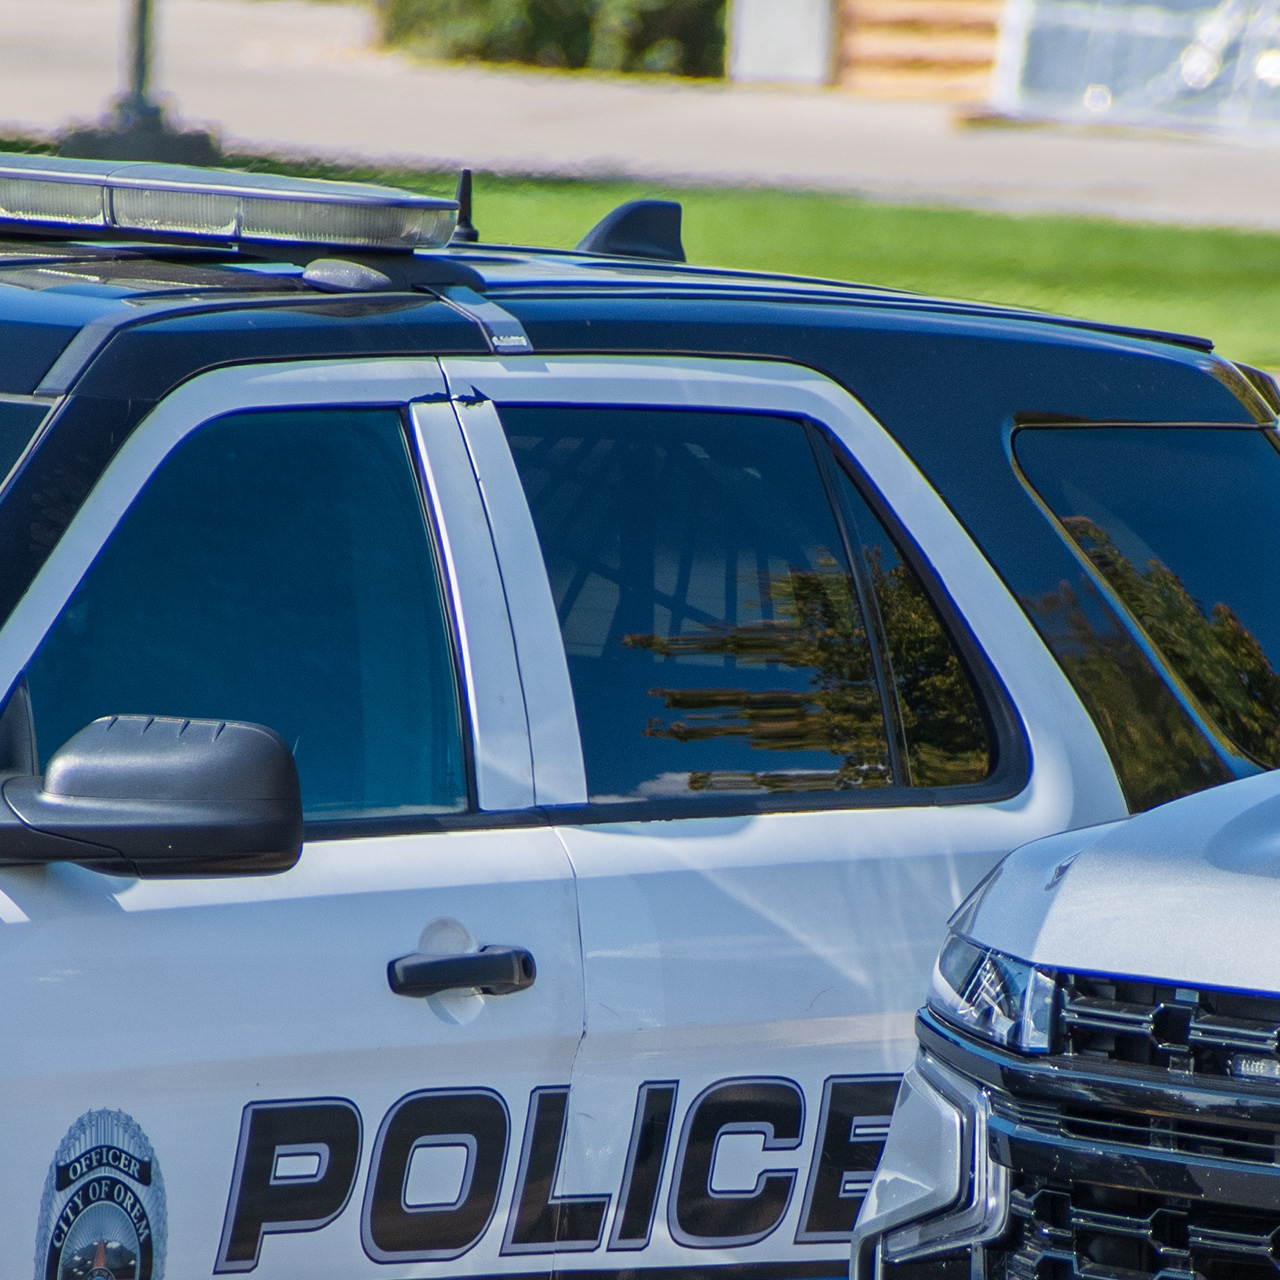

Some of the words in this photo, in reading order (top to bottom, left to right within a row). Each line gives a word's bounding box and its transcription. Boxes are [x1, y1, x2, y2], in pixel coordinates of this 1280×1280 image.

[68, 1147, 140, 1181] OFFICER
[213, 1072, 904, 1274] POLICE
[52, 1189, 84, 1248] CITY
[89, 1179, 111, 1201] OF
[113, 1183, 151, 1244] OREM
